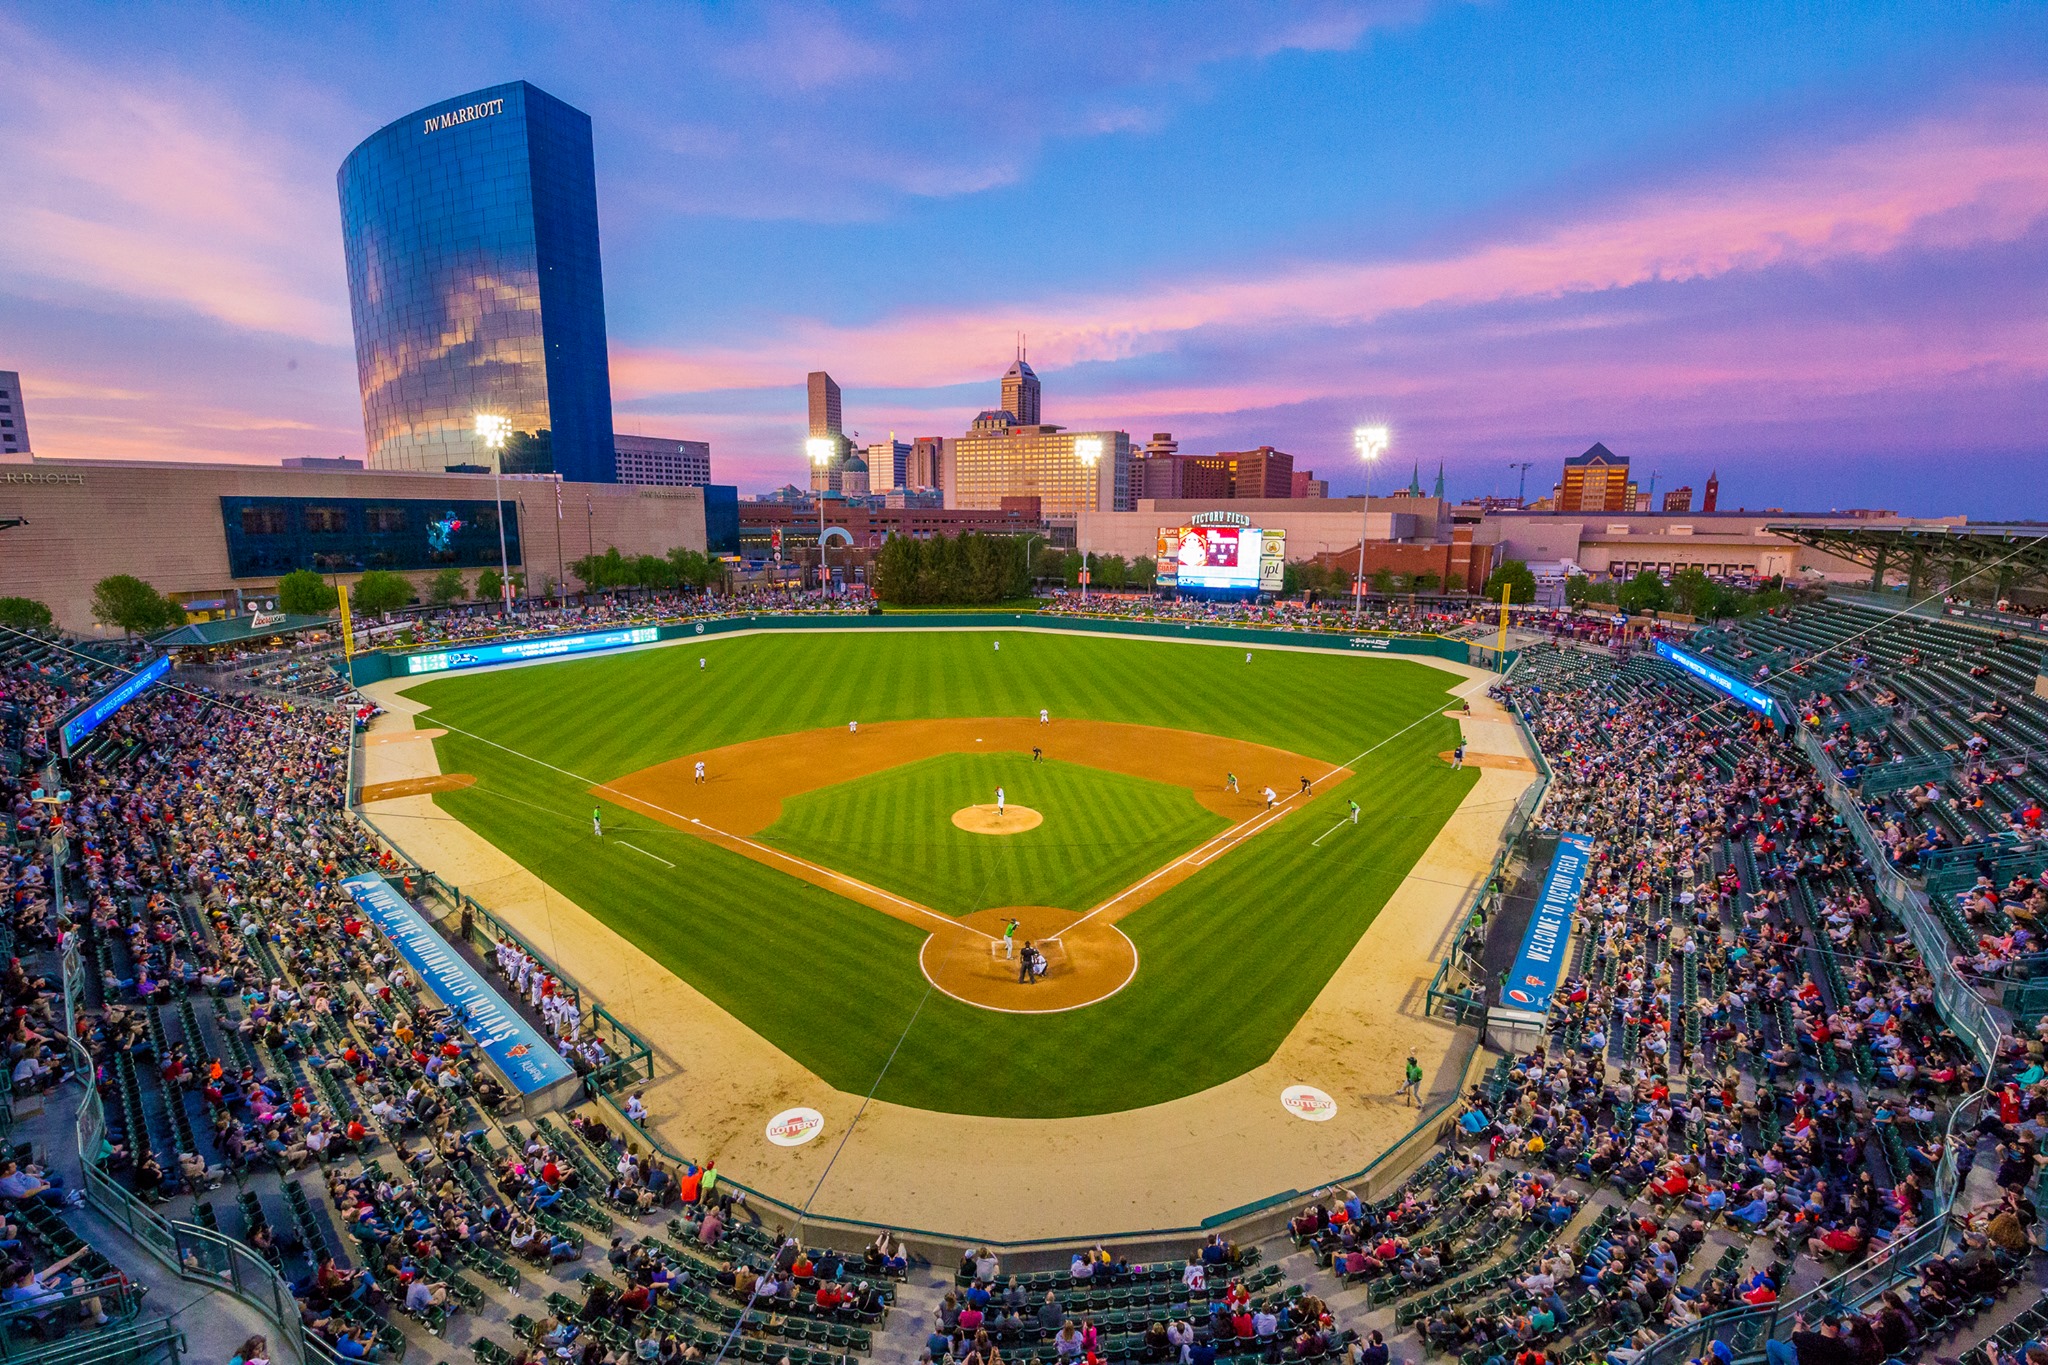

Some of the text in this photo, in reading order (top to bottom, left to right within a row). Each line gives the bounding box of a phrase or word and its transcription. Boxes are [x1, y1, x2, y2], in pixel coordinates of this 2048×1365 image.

[424, 98, 503, 134] JW MARRIOTT
[0, 472, 85, 486] RRIOTT
[1191, 511, 1250, 526] VICTORY FIELD
[1526, 854, 1579, 963] WELCOME TO VICTORY FIELD
[366, 890, 520, 1042] HOME OF THE INDIANAPOLIS INDIANS
[1285, 1098, 1331, 1109] LOTTERY
[770, 1118, 819, 1136] LOTTERY
[1191, 1275, 1204, 1288] 47
